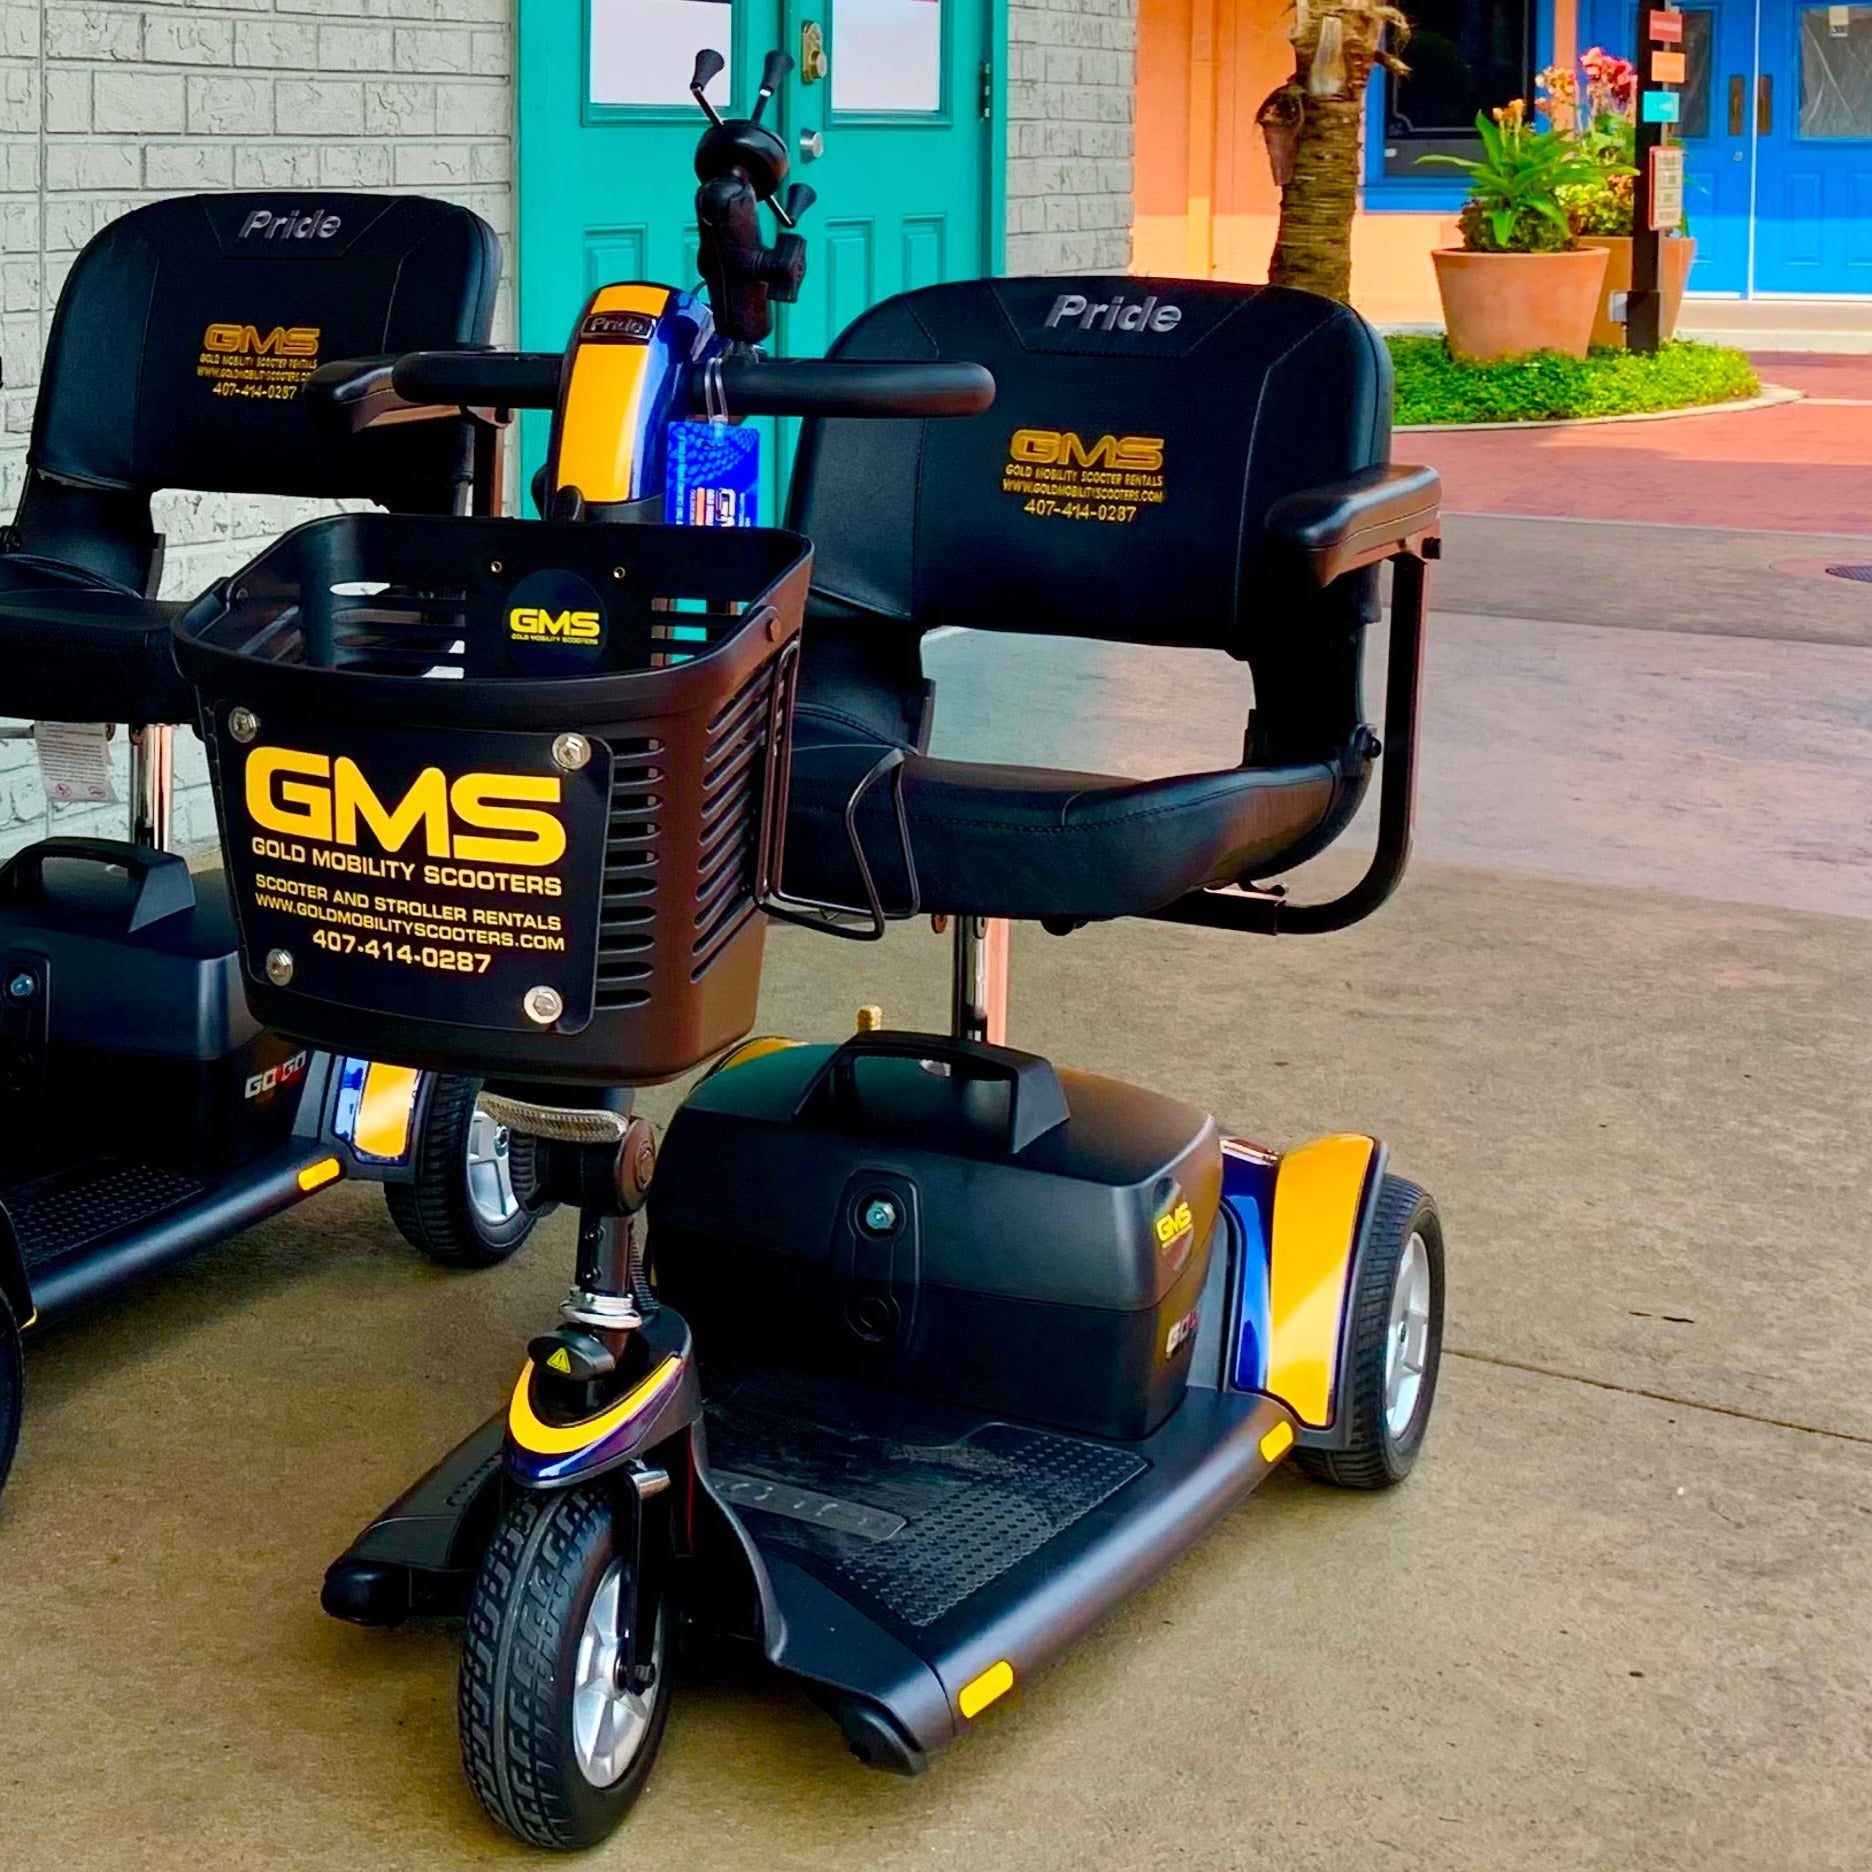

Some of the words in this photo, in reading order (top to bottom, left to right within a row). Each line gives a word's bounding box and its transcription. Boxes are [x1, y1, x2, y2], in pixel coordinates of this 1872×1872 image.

[239, 209, 342, 239] Pride
[591, 317, 644, 334] Pride
[1045, 295, 1182, 333] Pride
[204, 323, 321, 356] GMS
[212, 382, 298, 400] 407-414-0287
[1010, 429, 1165, 471] GMS
[1003, 478, 1163, 502] WWW.GOLDMOBILITYSCOOTERS.COM
[1005, 464, 1033, 478] GOLD
[1035, 469, 1077, 482] MOBILITY
[1081, 471, 1122, 485] SCOOTER
[1124, 474, 1163, 487] RENTALS
[1024, 499, 1137, 522] 407-414-0287
[510, 608, 600, 637] GMS
[245, 746, 567, 866] GMS
[252, 836, 306, 863] GOLD
[312, 848, 416, 881] MOBILITY
[424, 866, 562, 897] SCOOTERS
[255, 873, 329, 902] SCOOTER
[332, 889, 369, 909] AND
[374, 896, 467, 922] STROLLER
[473, 910, 561, 931] RENTALS
[255, 892, 565, 951] WWW.GOLDMOBILITYSCOOTERS.COM
[1156, 1202, 1192, 1241] GMS
